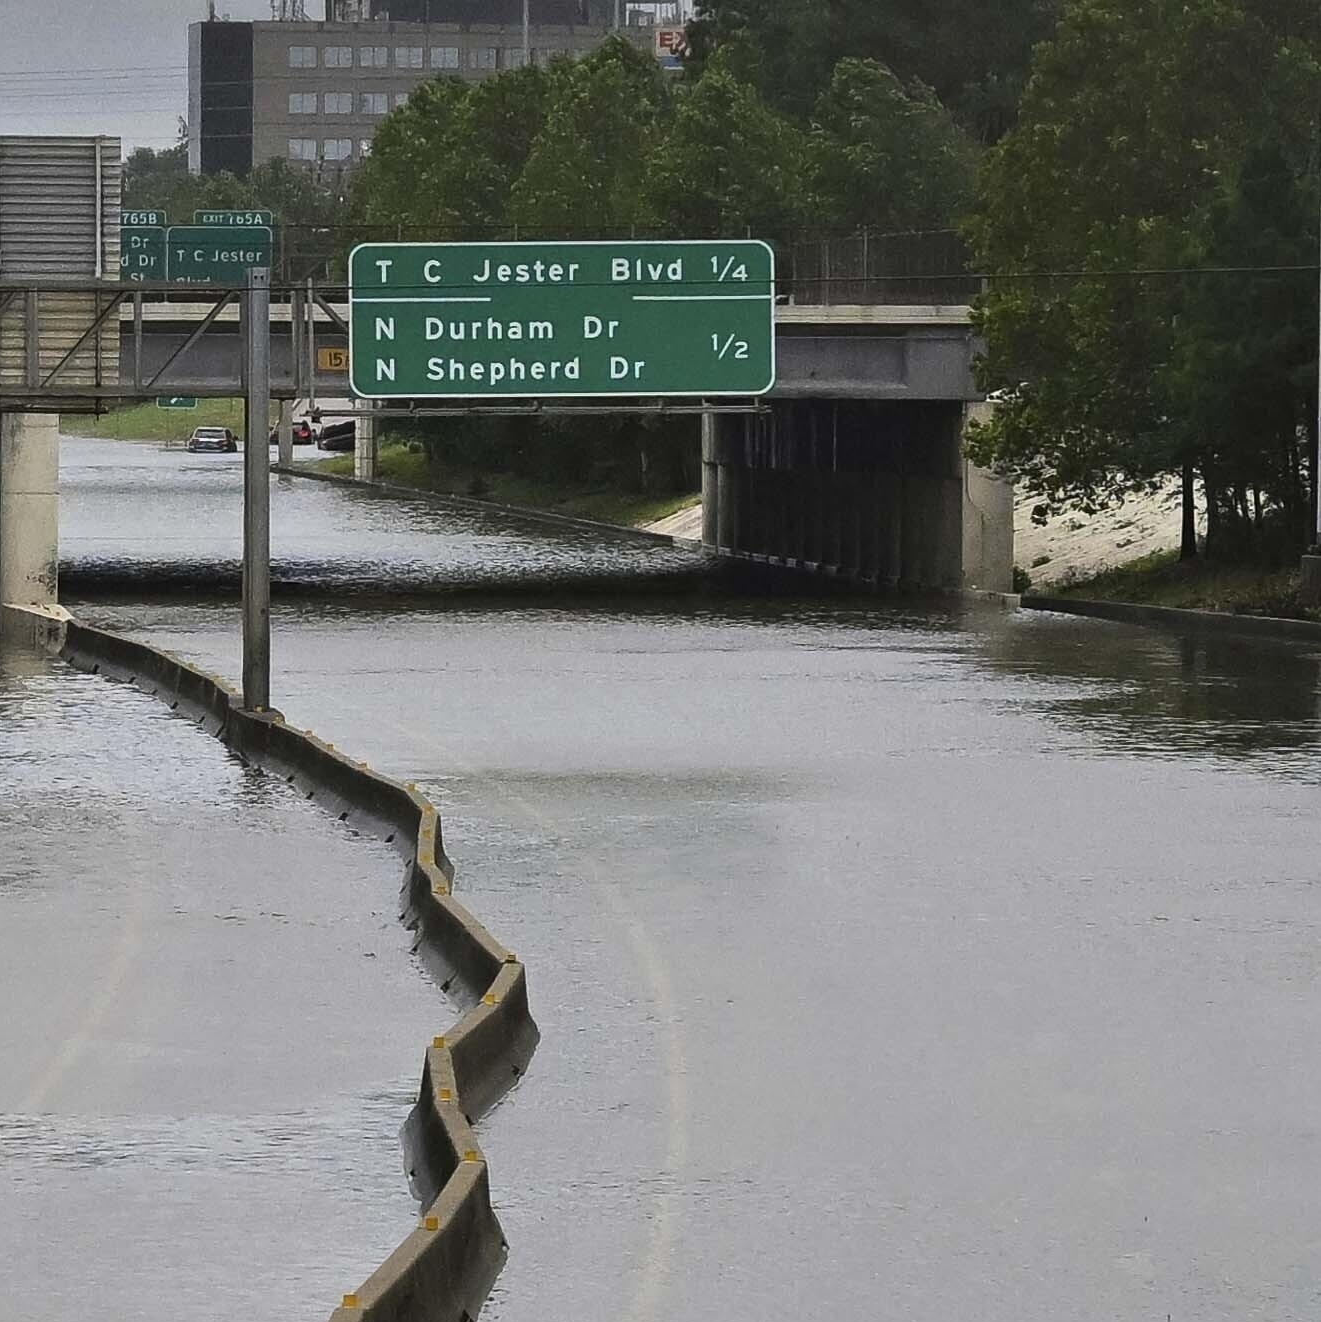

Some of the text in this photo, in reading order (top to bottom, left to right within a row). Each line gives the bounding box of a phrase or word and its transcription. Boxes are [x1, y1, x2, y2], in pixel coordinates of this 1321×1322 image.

[122, 213, 157, 225] 765B
[202, 213, 263, 225] EXIT 765A
[131, 235, 149, 249] Dr
[139, 254, 157, 267] Dr
[176, 249, 263, 262] T C Jester
[375, 260, 393, 283] T
[423, 259, 442, 283] C
[473, 259, 580, 282] Jester
[611, 258, 683, 281] Blvd
[375, 316, 620, 341] N Durham Dr
[375, 358, 395, 381] N
[426, 357, 580, 386] Shepherd
[610, 356, 646, 379] Dr
